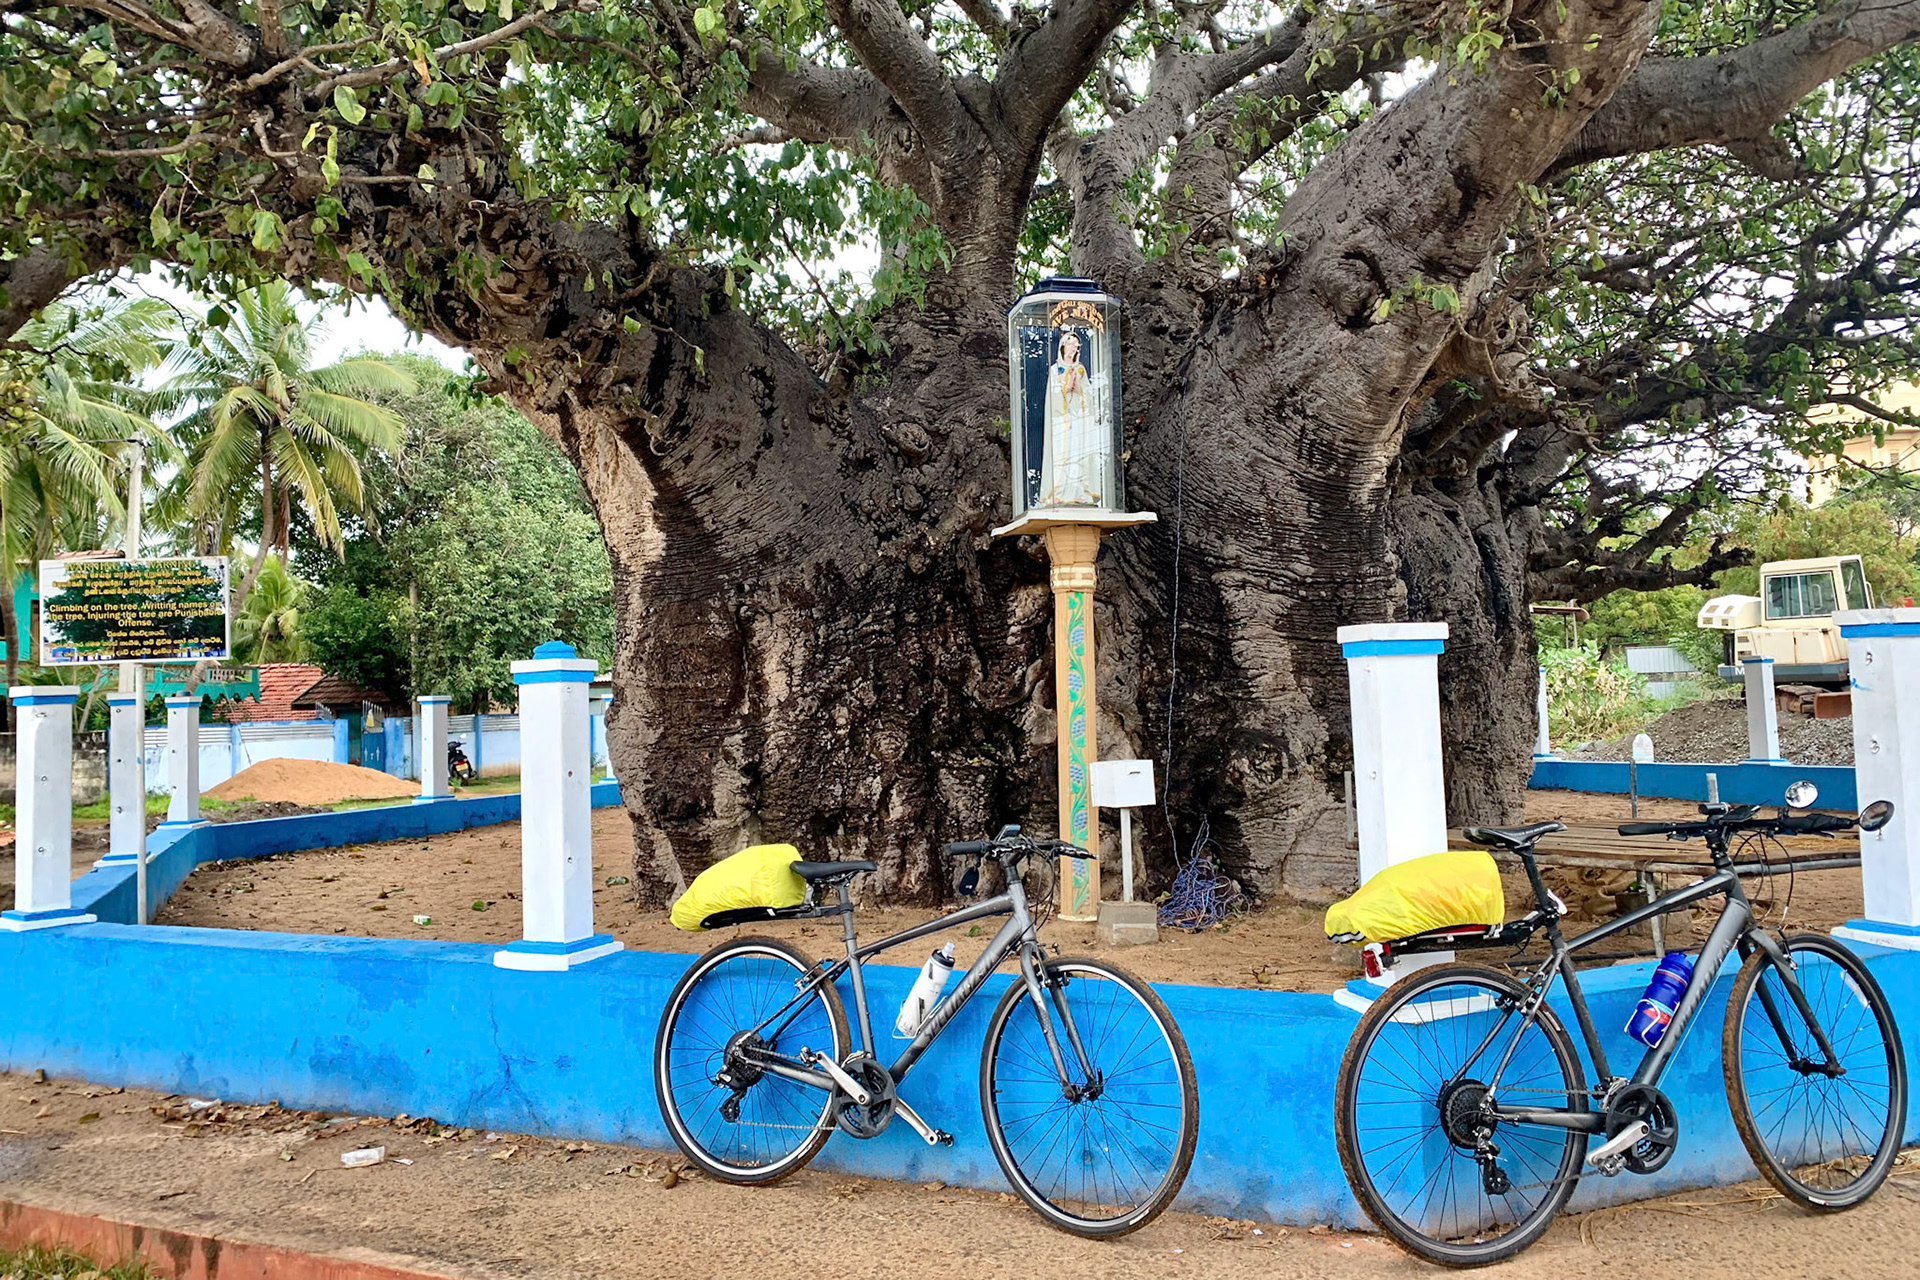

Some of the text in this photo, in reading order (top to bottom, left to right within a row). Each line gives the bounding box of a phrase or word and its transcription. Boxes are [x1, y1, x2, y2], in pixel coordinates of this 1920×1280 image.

[1072, 308, 1105, 334] MARIA
[63, 560, 196, 571] WARNING WARNING
[49, 604, 89, 613] Climbing
[104, 603, 118, 611] the
[142, 602, 177, 611] Writting
[178, 601, 208, 609] names
[48, 612, 64, 620] the
[87, 611, 121, 621] Injuring
[121, 611, 137, 619] the
[138, 610, 156, 618] tree
[118, 618, 155, 627] Offense.
